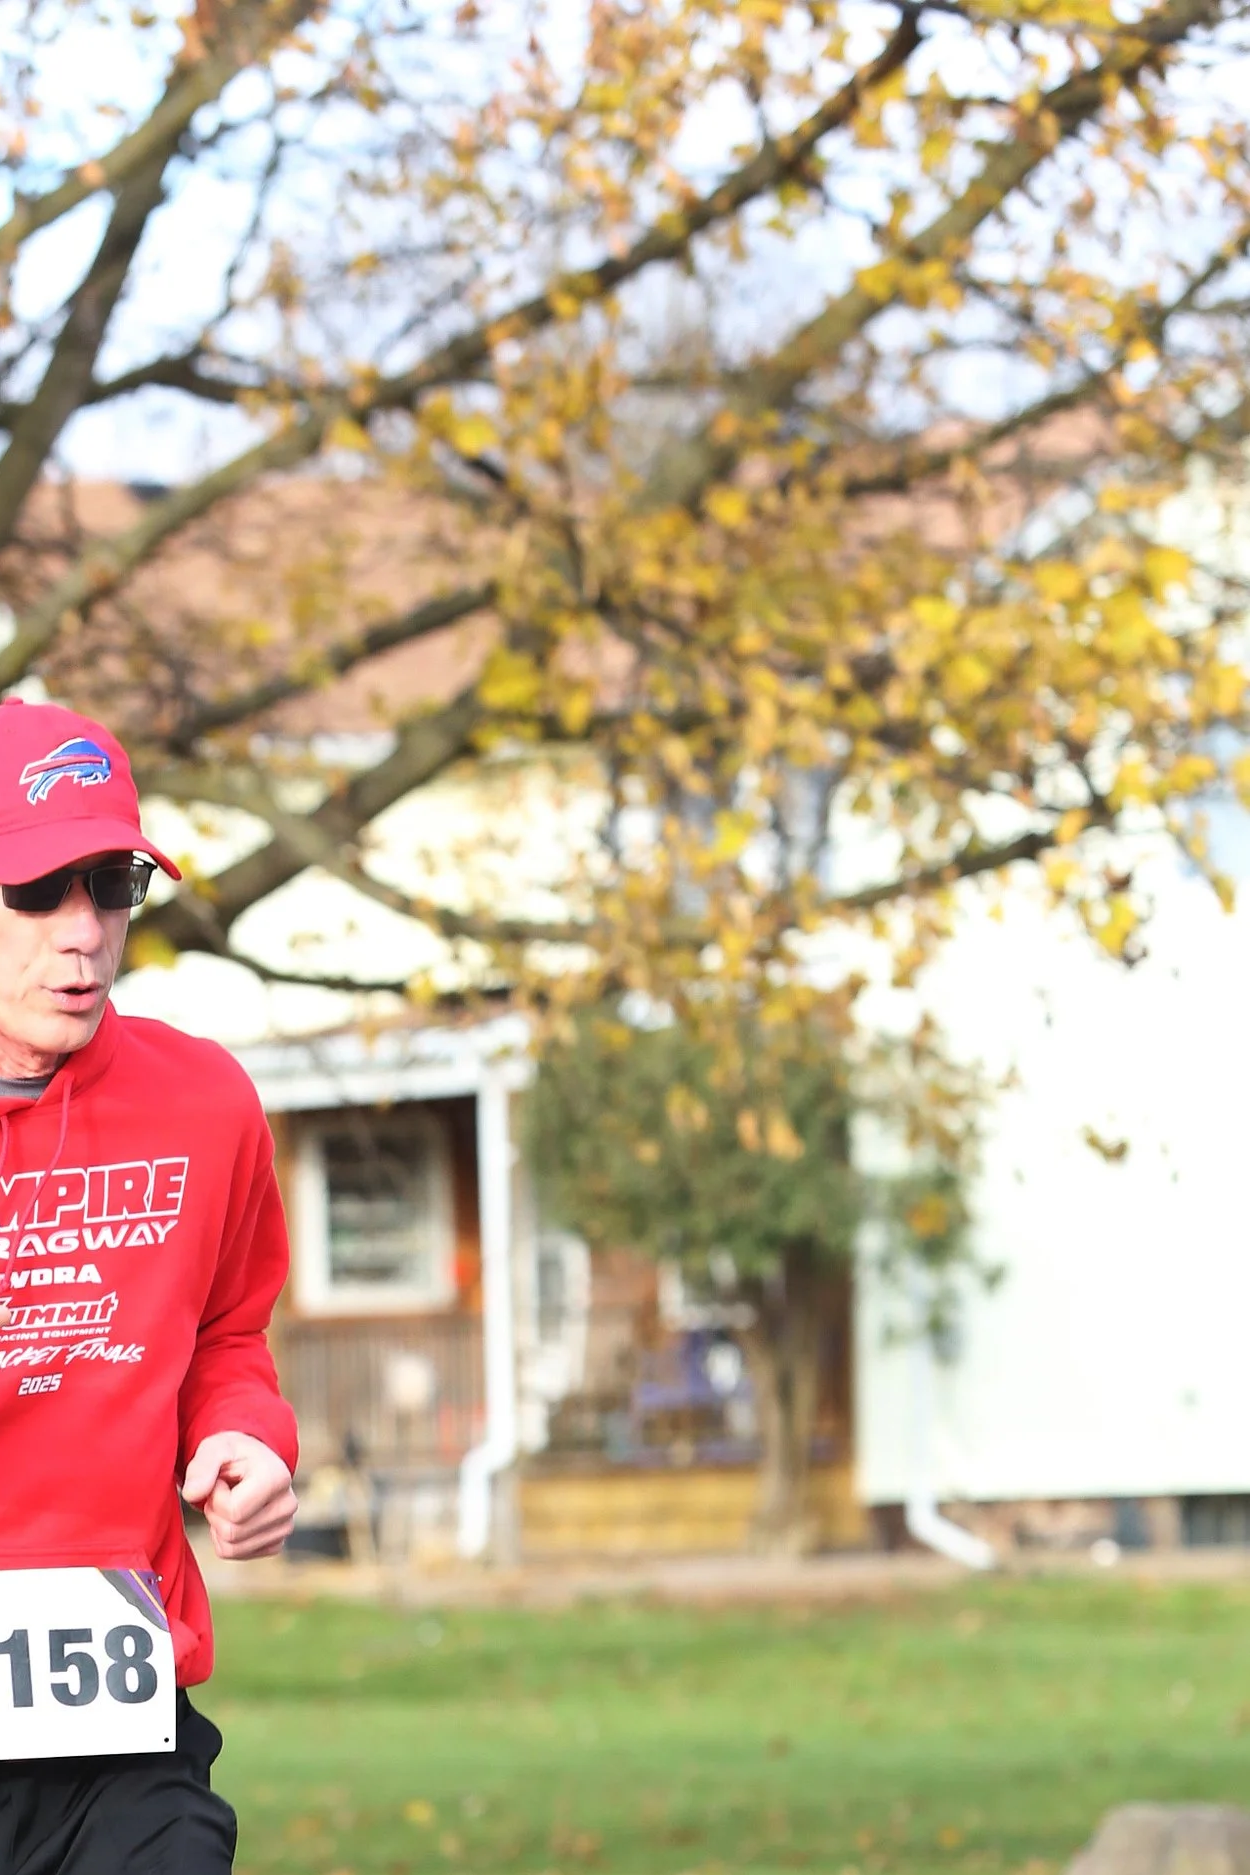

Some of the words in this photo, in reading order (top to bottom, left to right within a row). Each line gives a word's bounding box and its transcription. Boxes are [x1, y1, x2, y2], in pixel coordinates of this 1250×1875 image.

[0, 1264, 102, 1289] WDRA
[42, 1326, 112, 1339] EQUIPMENT
[64, 1336, 146, 1366] FINALS
[17, 1373, 63, 1396] 2025
